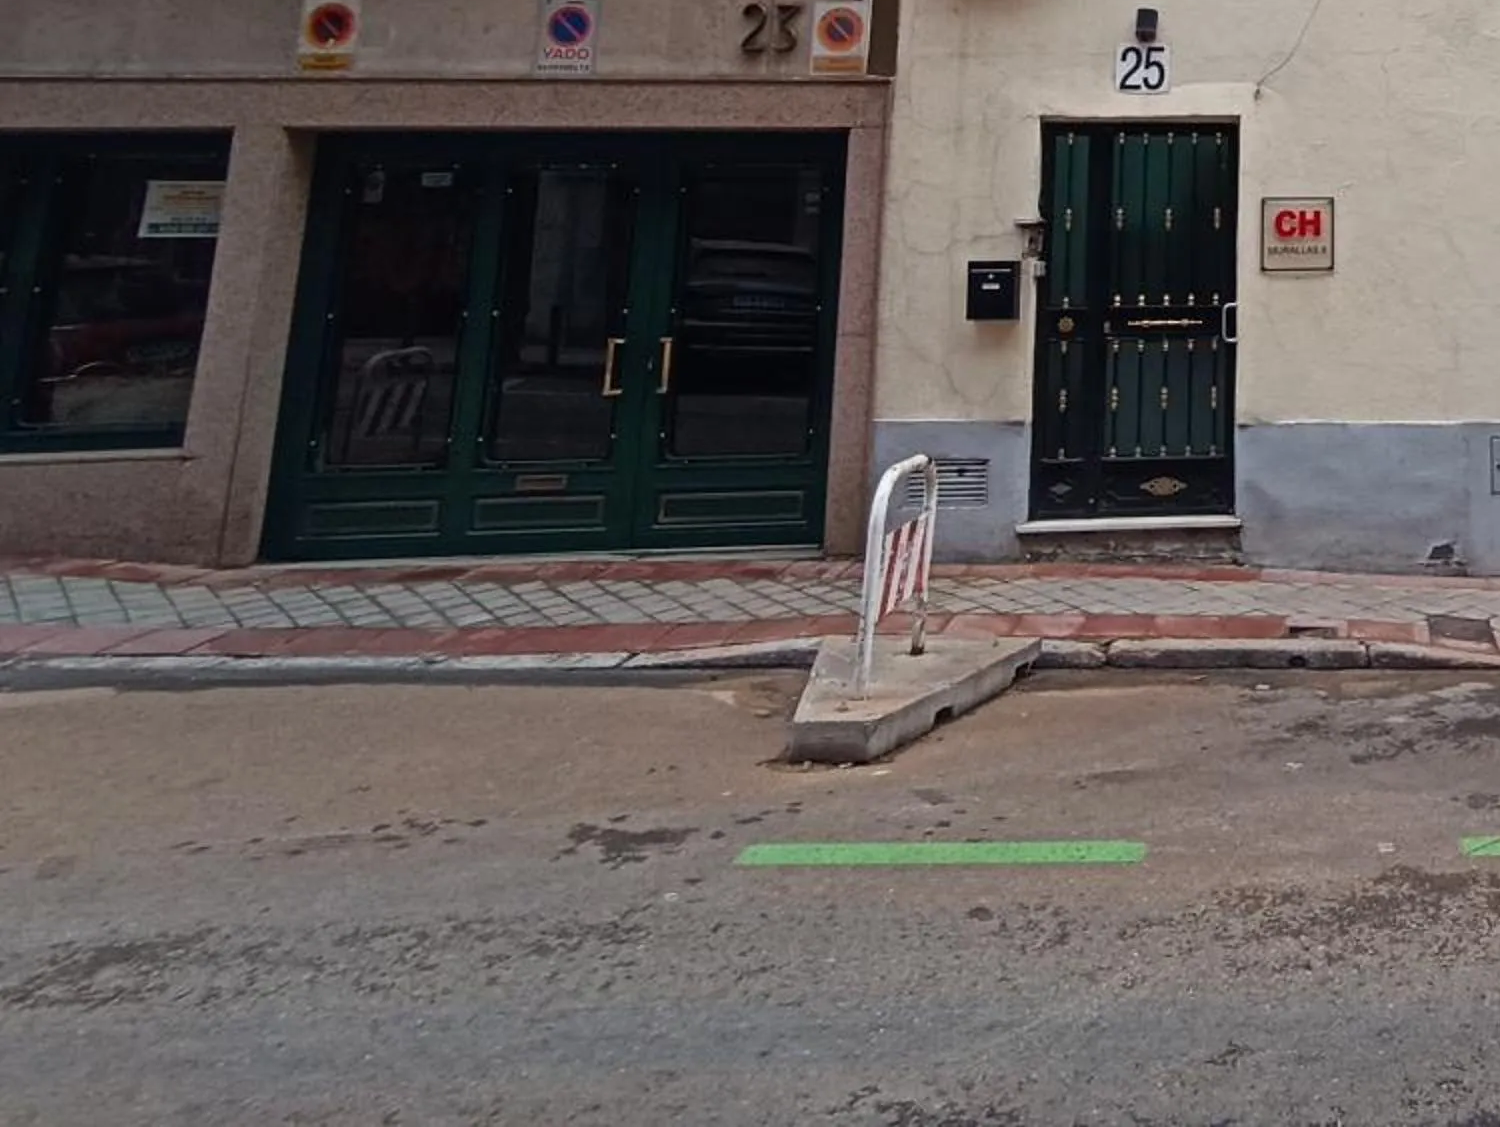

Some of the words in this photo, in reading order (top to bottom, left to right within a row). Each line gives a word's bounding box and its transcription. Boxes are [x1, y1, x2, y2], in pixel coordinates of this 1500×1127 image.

[742, 4, 803, 54] 23
[543, 47, 590, 60] VADO
[1119, 46, 1165, 90] 25
[1275, 210, 1321, 237] CH
